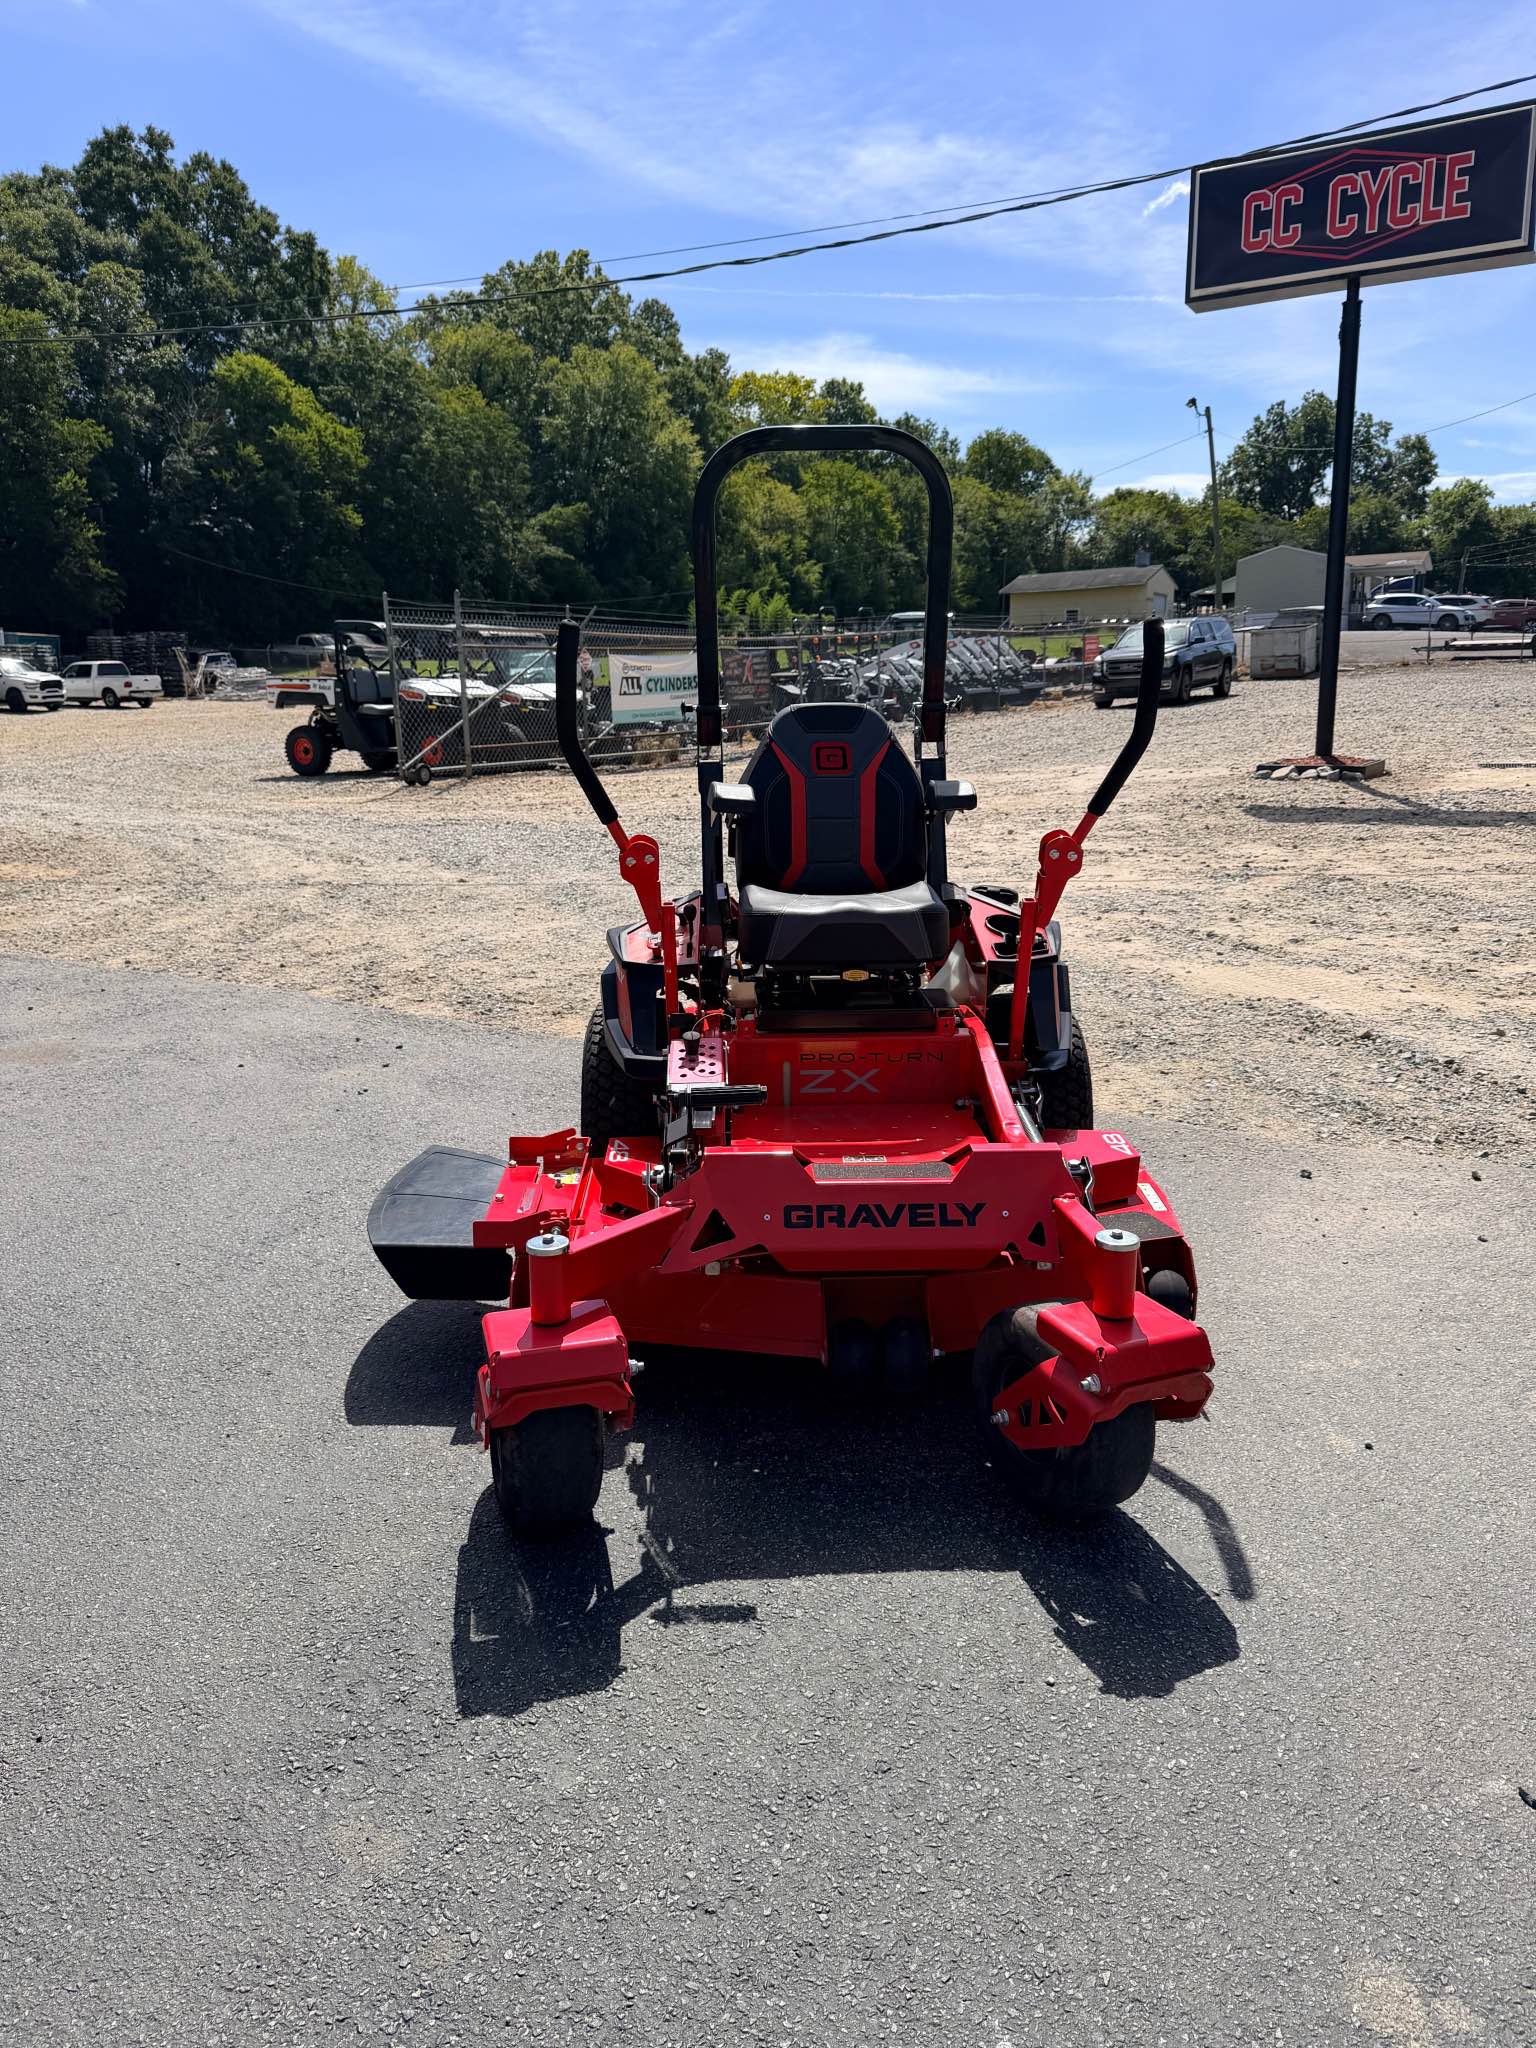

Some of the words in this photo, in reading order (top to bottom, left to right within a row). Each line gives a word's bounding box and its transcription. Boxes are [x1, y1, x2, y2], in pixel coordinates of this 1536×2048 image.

[1241, 184, 1304, 254] CC
[1326, 150, 1476, 239] CYCLE
[620, 678, 641, 695] ALL
[646, 675, 698, 692] CYLINDERS
[799, 1052, 944, 1063] PRO-TURN
[799, 1068, 881, 1094] ZX
[608, 1139, 630, 1163] 48
[1101, 1133, 1134, 1156] 48
[783, 1203, 988, 1229] GRAVELY
